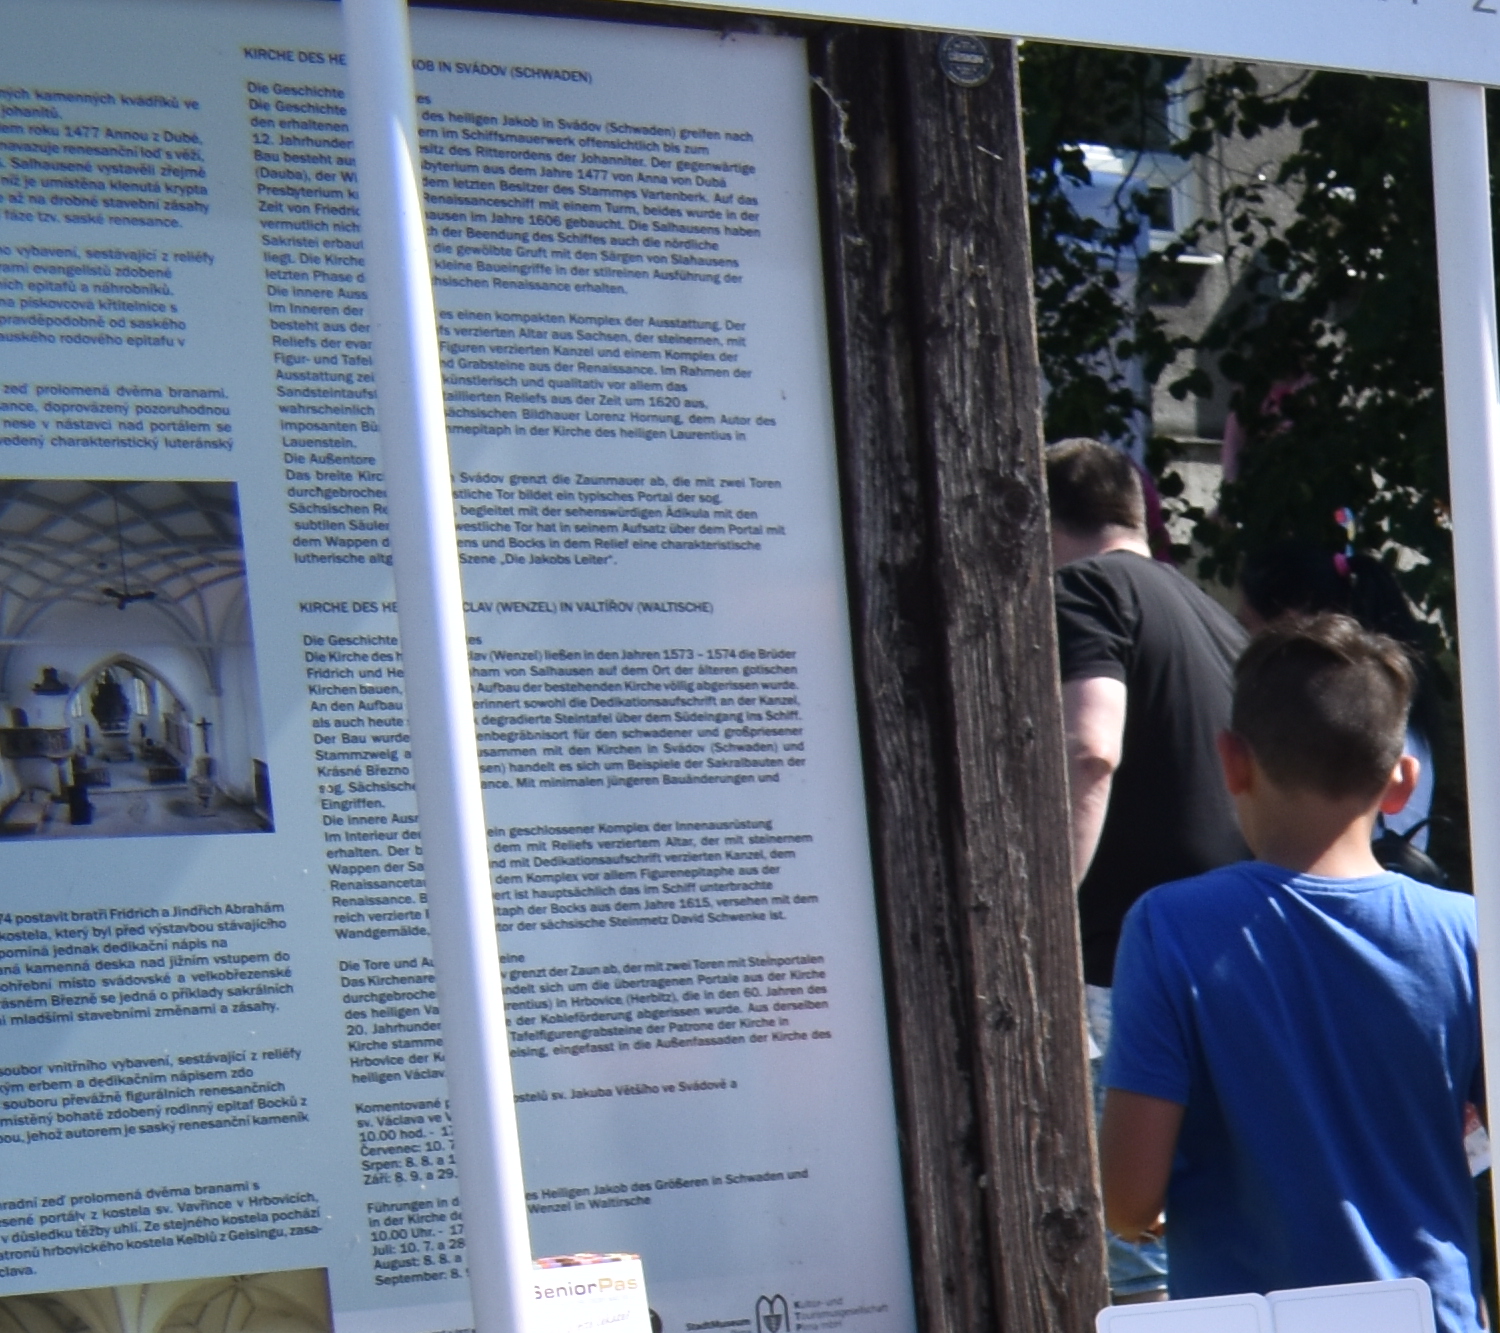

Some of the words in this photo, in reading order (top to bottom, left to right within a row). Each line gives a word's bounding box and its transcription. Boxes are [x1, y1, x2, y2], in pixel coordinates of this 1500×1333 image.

[241, 46, 295, 62] KIRCHE
[295, 49, 326, 65] DES
[436, 60, 453, 73] IN
[453, 60, 508, 77] SVÁDOV
[508, 65, 593, 83] (SCHWADEN)
[246, 97, 272, 112] Die
[272, 99, 348, 116] Geschichte
[419, 109, 445, 123] des
[446, 110, 499, 128] heiligen
[500, 114, 540, 128] Jakob
[540, 116, 555, 129] in
[556, 117, 602, 133] Svádov
[603, 120, 677, 137] (Schwaden)
[677, 126, 722, 143] greifen
[723, 129, 754, 143] nach
[1, 381, 30, 395] zeď
[33, 383, 111, 398] prolomená
[113, 384, 163, 398] dvěma
[166, 385, 229, 399] branami.
[298, 600, 349, 613] KIRCHE
[350, 600, 379, 613] DES
[494, 600, 558, 614] (WENZEL)
[558, 601, 574, 612] IN
[574, 598, 635, 613] VALTÍŘOV
[635, 600, 714, 613] (WALTISCHE)
